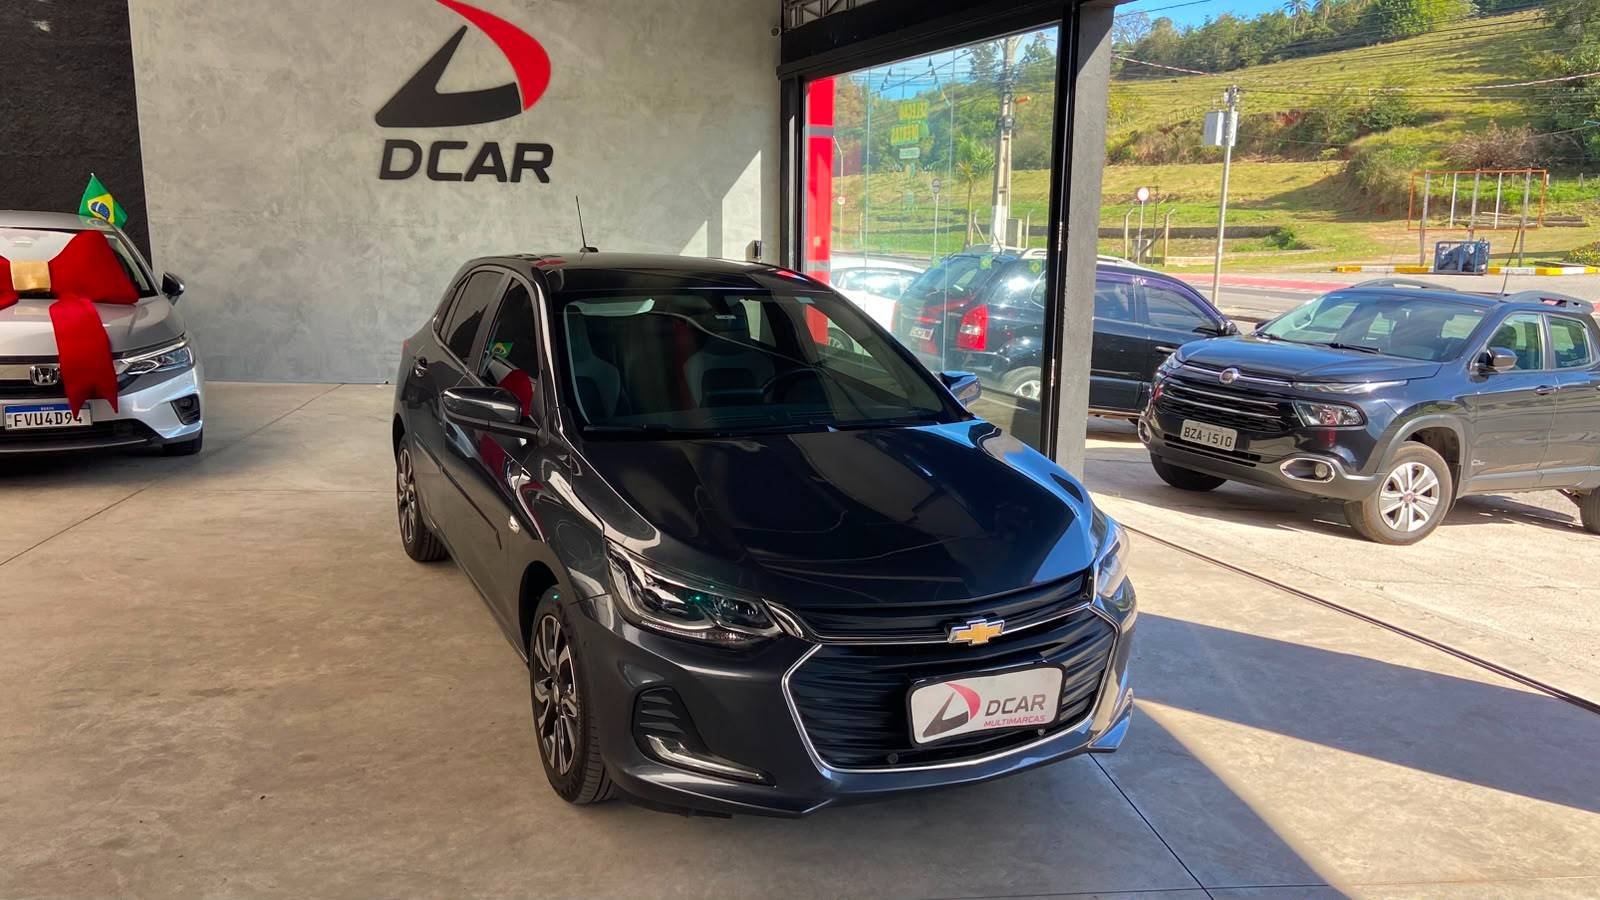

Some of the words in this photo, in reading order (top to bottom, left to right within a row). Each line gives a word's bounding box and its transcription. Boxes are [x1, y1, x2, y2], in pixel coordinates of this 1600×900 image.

[379, 139, 554, 184] DCAR
[1183, 426, 1233, 447] BZA-1510
[984, 694, 1046, 716] DCAR
[984, 715, 1047, 727] MULTIMARCAS
